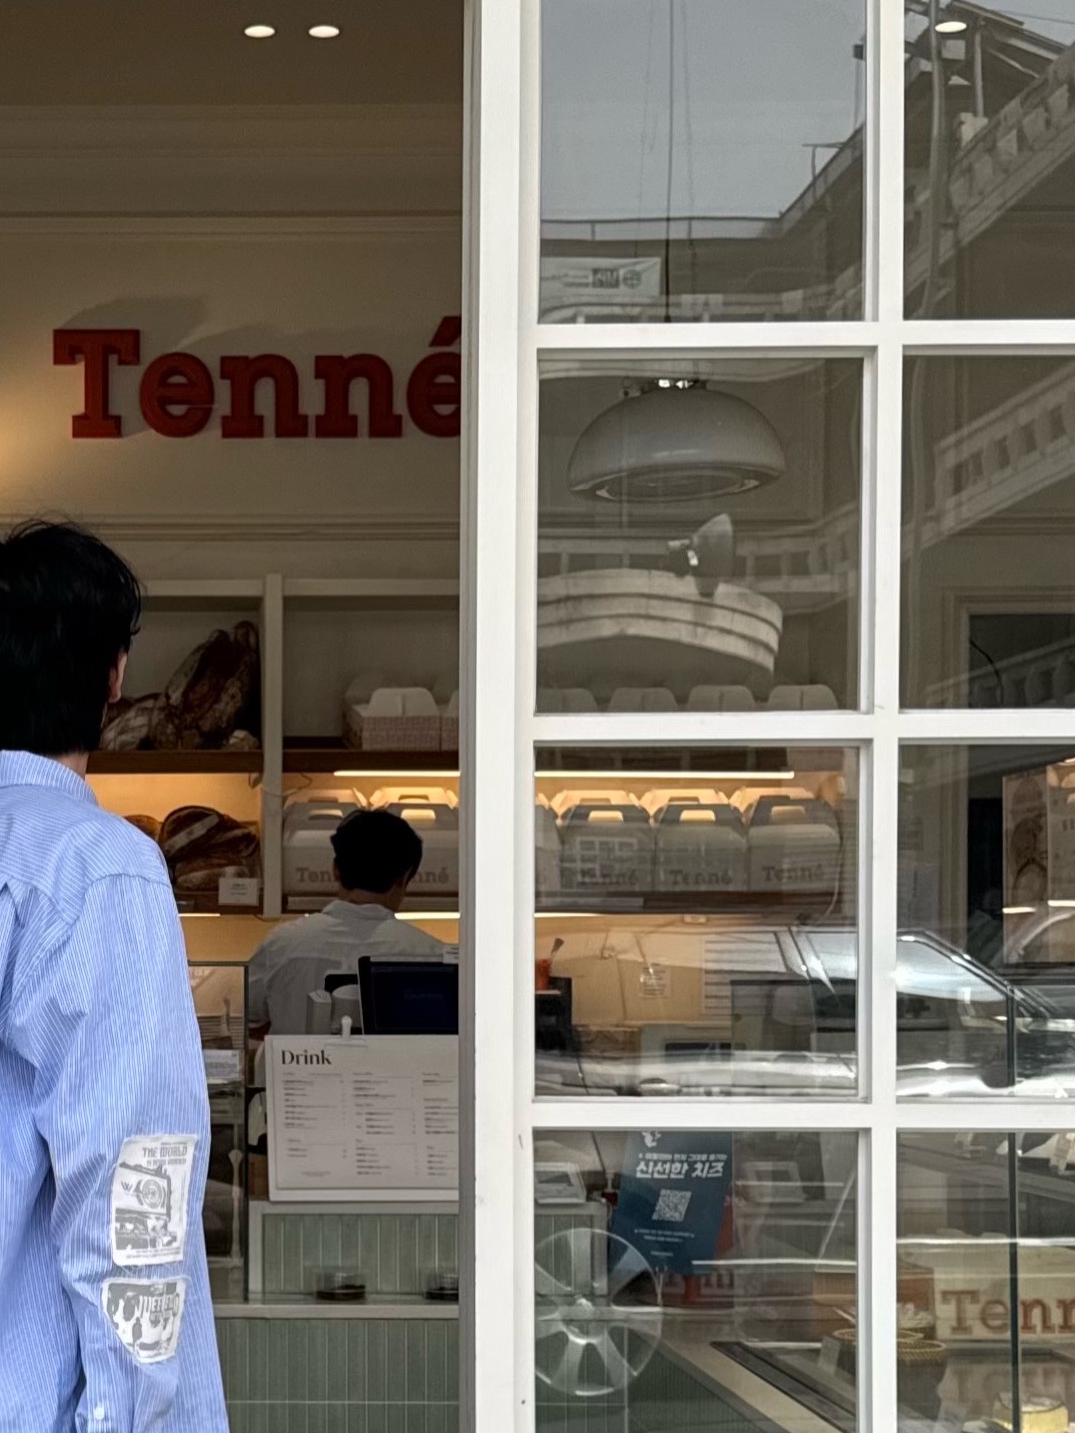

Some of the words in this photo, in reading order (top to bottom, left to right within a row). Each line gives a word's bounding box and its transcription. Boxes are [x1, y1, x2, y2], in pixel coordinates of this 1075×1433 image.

[53, 315, 461, 438] Tenné
[281, 1050, 332, 1065] Drink
[142, 1147, 158, 1158] THE
[635, 1161, 689, 1179] 신선한
[691, 1161, 725, 1179] 치즈
